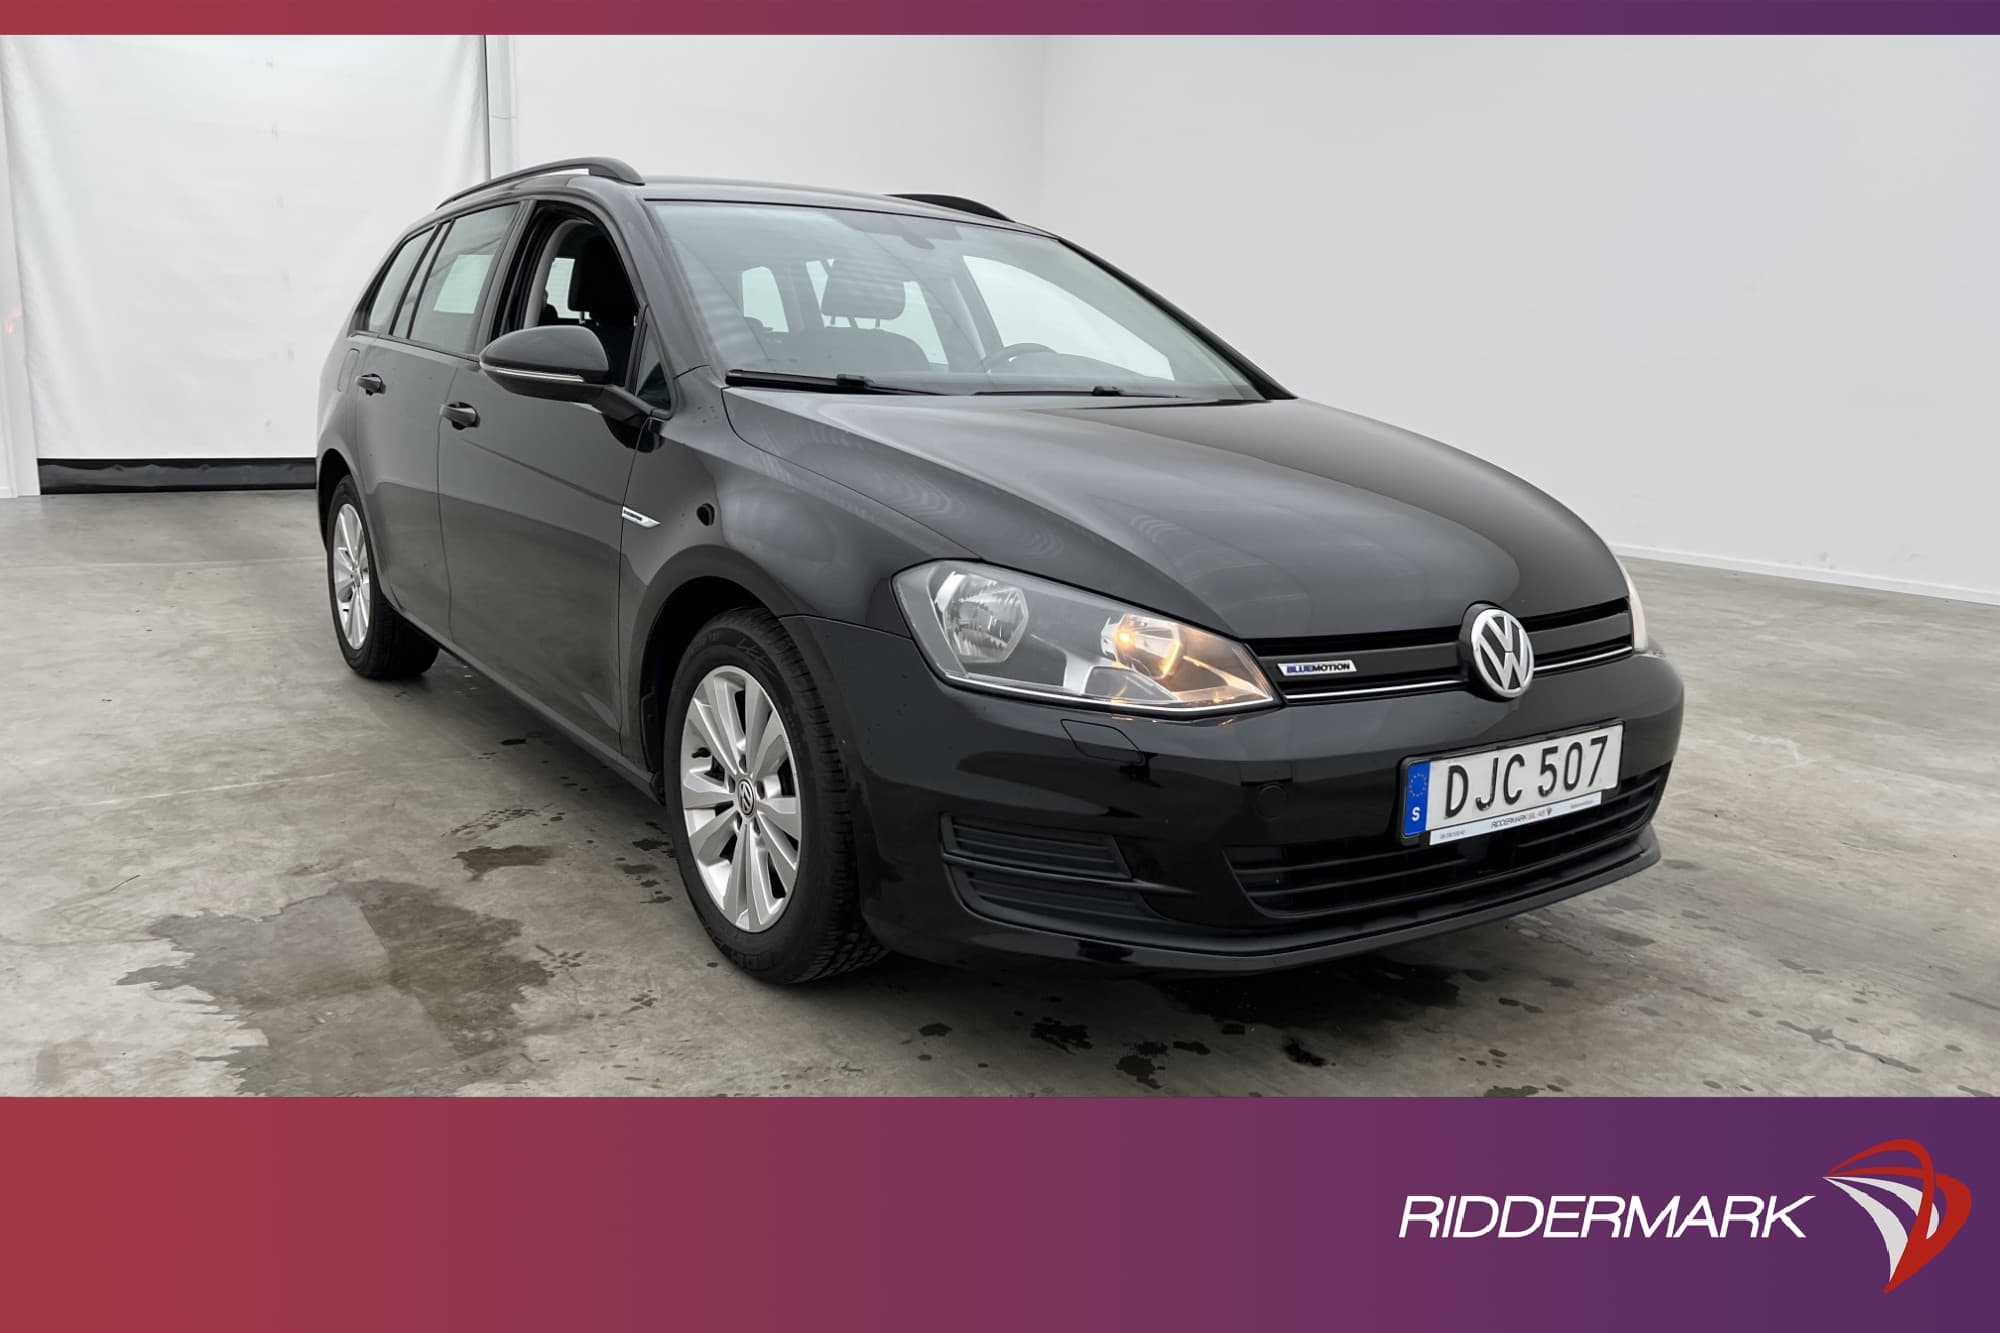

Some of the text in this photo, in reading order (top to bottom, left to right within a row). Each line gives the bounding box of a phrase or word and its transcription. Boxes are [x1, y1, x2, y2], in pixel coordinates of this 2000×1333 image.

[1285, 662, 1351, 674] BLUEMOTION
[1445, 735, 1609, 820] DJC 507
[1411, 806, 1421, 822] S
